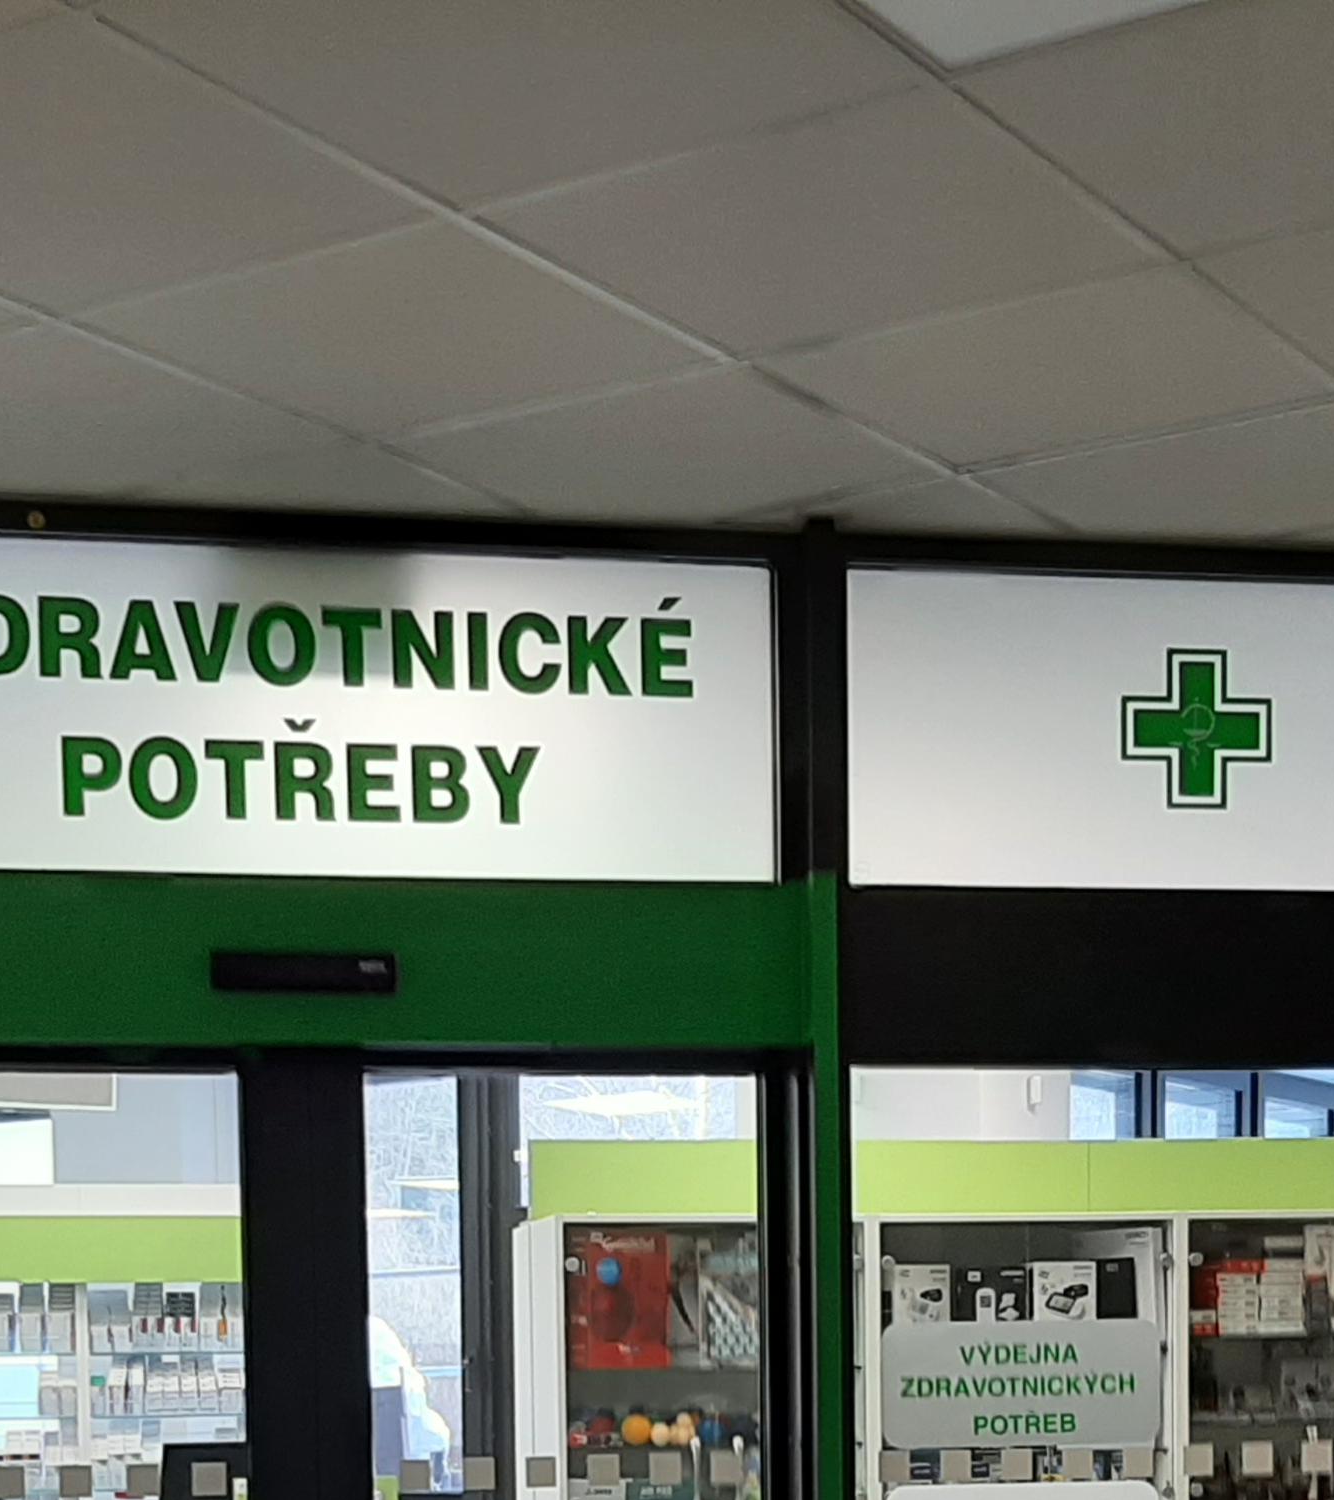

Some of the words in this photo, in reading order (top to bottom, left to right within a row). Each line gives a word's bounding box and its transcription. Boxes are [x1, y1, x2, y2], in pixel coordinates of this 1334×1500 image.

[60, 718, 541, 826] POTŘEBY
[959, 1341, 1078, 1366] VÝDEJNA
[900, 1370, 1136, 1398] ZDRAVOTNICKÝCH
[974, 1409, 1076, 1436] POTŘEB
